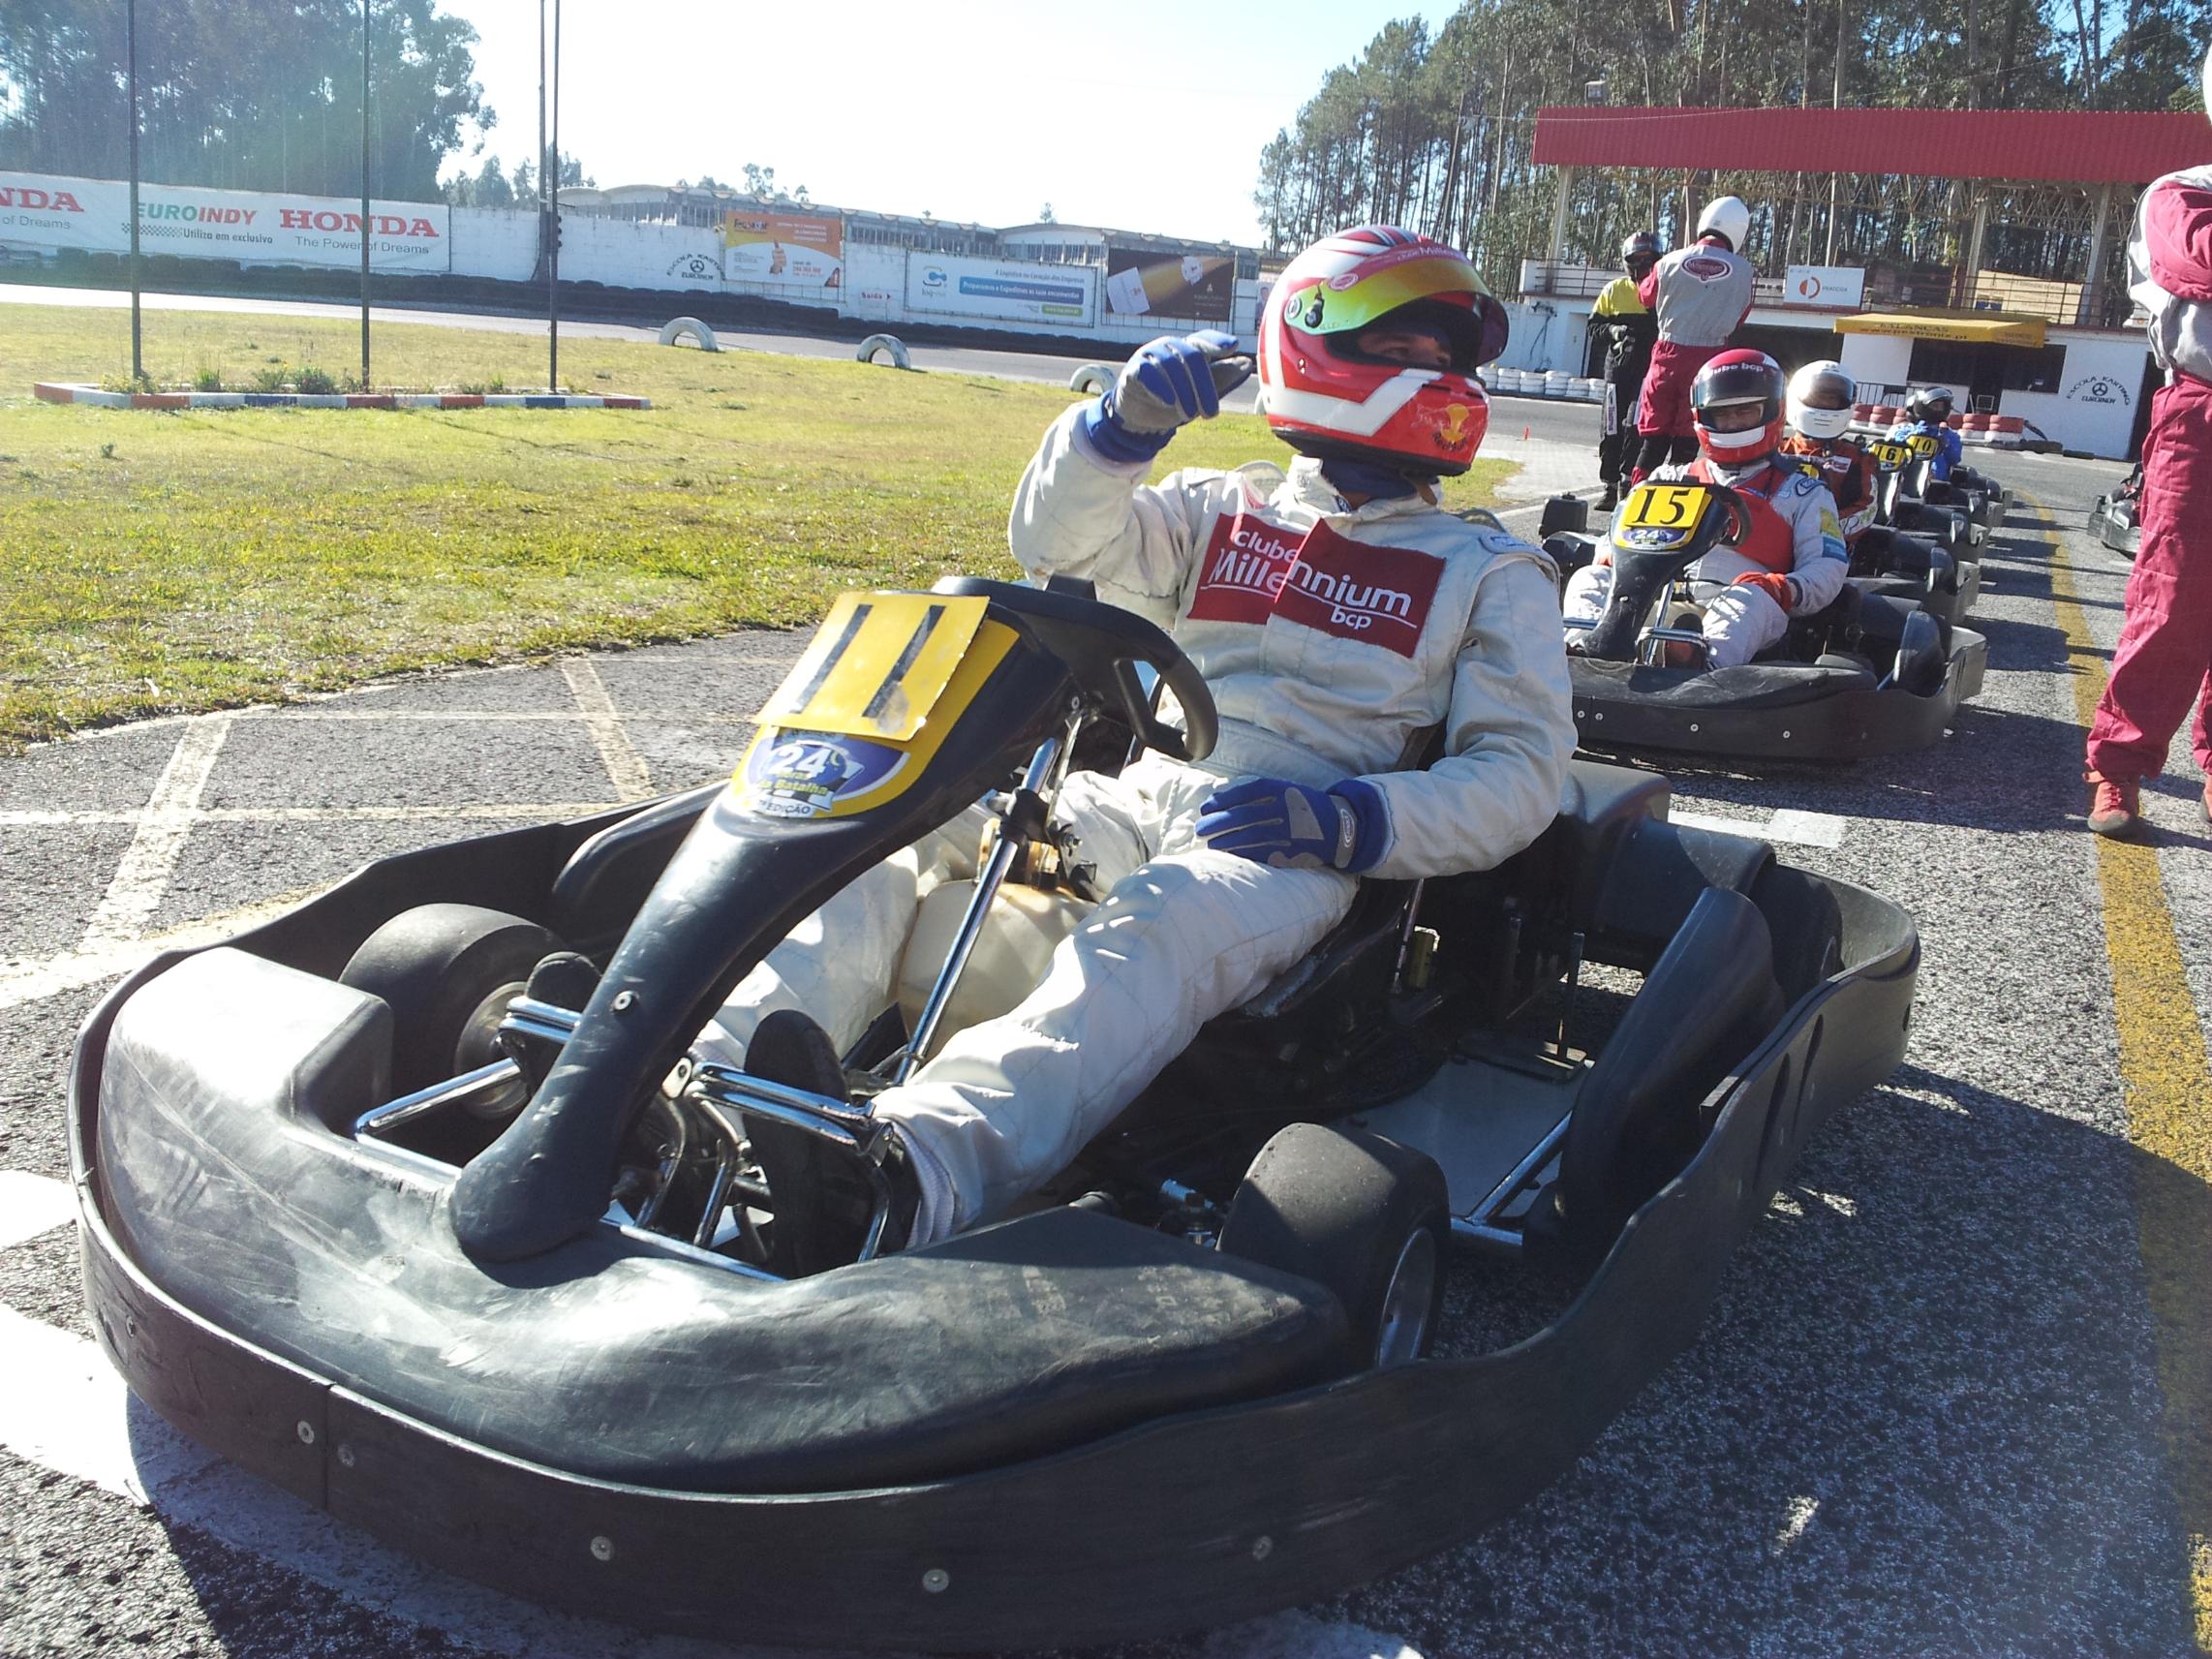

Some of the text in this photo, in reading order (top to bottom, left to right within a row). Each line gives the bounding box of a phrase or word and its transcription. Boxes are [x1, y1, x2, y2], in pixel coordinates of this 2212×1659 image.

[19, 215, 71, 230] Dreams
[138, 202, 258, 226] EUROINDY
[279, 208, 440, 237] HONDA
[183, 228, 213, 240] Utiliza
[231, 232, 273, 244] exclusivo
[294, 235, 319, 247] The
[323, 238, 362, 251] Power
[381, 244, 429, 255] Dreams
[1741, 362, 1765, 372] bcp
[1632, 487, 1691, 525] 15
[1331, 604, 1372, 630] bcp
[788, 603, 947, 719] 11
[766, 743, 832, 779] 24
